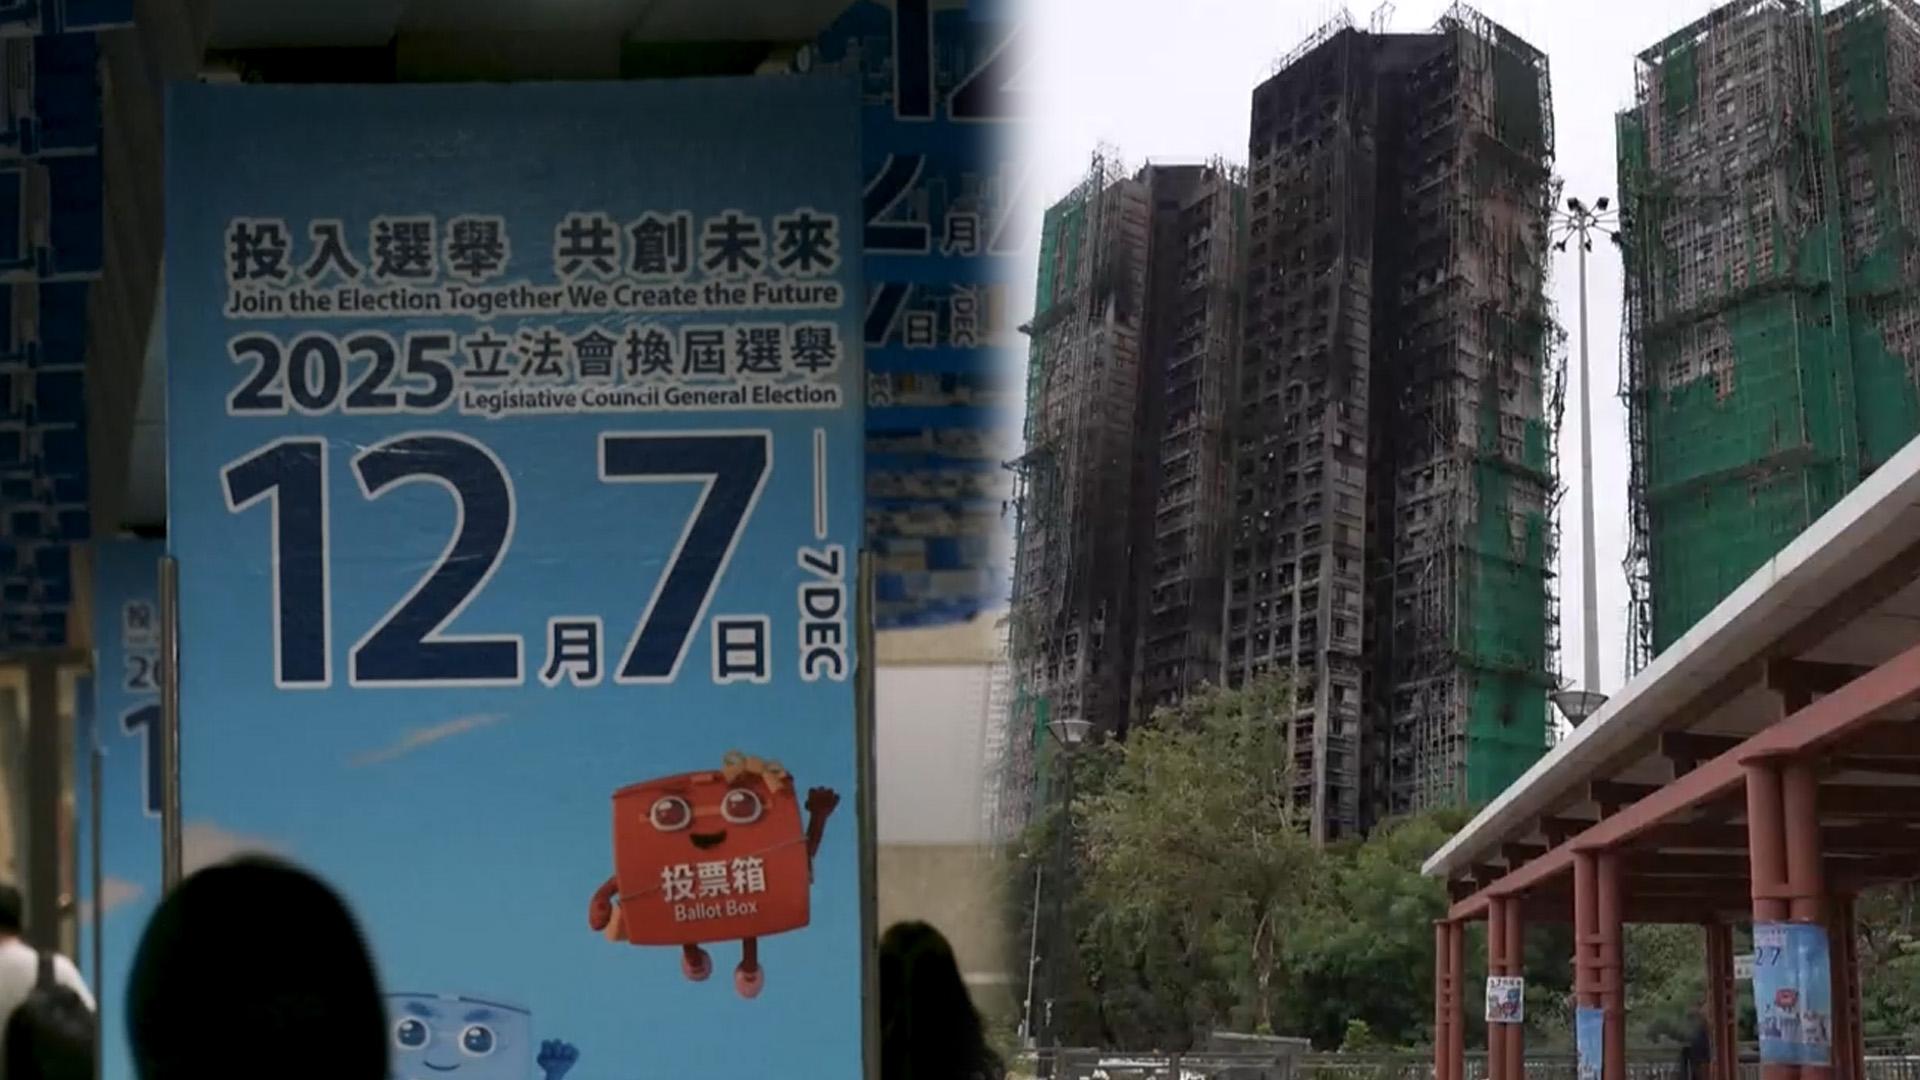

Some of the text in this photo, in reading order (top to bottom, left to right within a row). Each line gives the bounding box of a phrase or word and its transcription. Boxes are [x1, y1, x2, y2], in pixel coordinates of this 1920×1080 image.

[230, 213, 835, 281] 投入選舉 共創未來
[229, 281, 838, 314] Join the Election Together We Create the Future
[231, 327, 837, 411] 2025 立法會換屆選舉
[463, 384, 837, 412] Legislative Council General Election
[803, 587, 844, 677] DEC
[660, 855, 768, 902] 投票箱
[674, 899, 758, 923] Ballot Box
